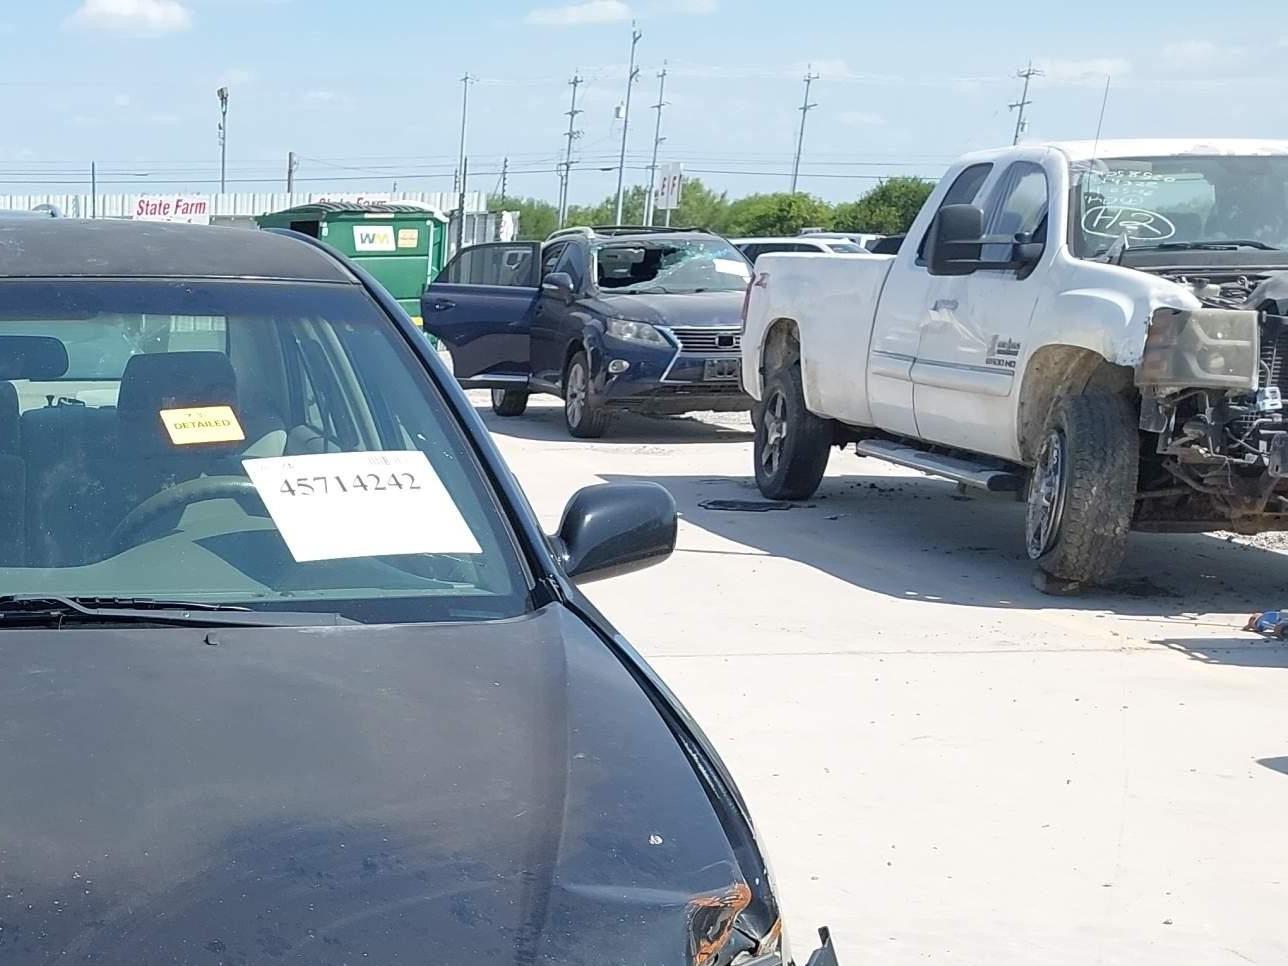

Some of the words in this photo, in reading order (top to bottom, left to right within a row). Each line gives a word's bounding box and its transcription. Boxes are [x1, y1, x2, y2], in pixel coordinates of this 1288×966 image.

[136, 199, 170, 216] State
[174, 198, 206, 215] Farm
[360, 232, 390, 245] WM
[173, 419, 231, 430] DETAILED
[279, 473, 422, 496] 45714242
